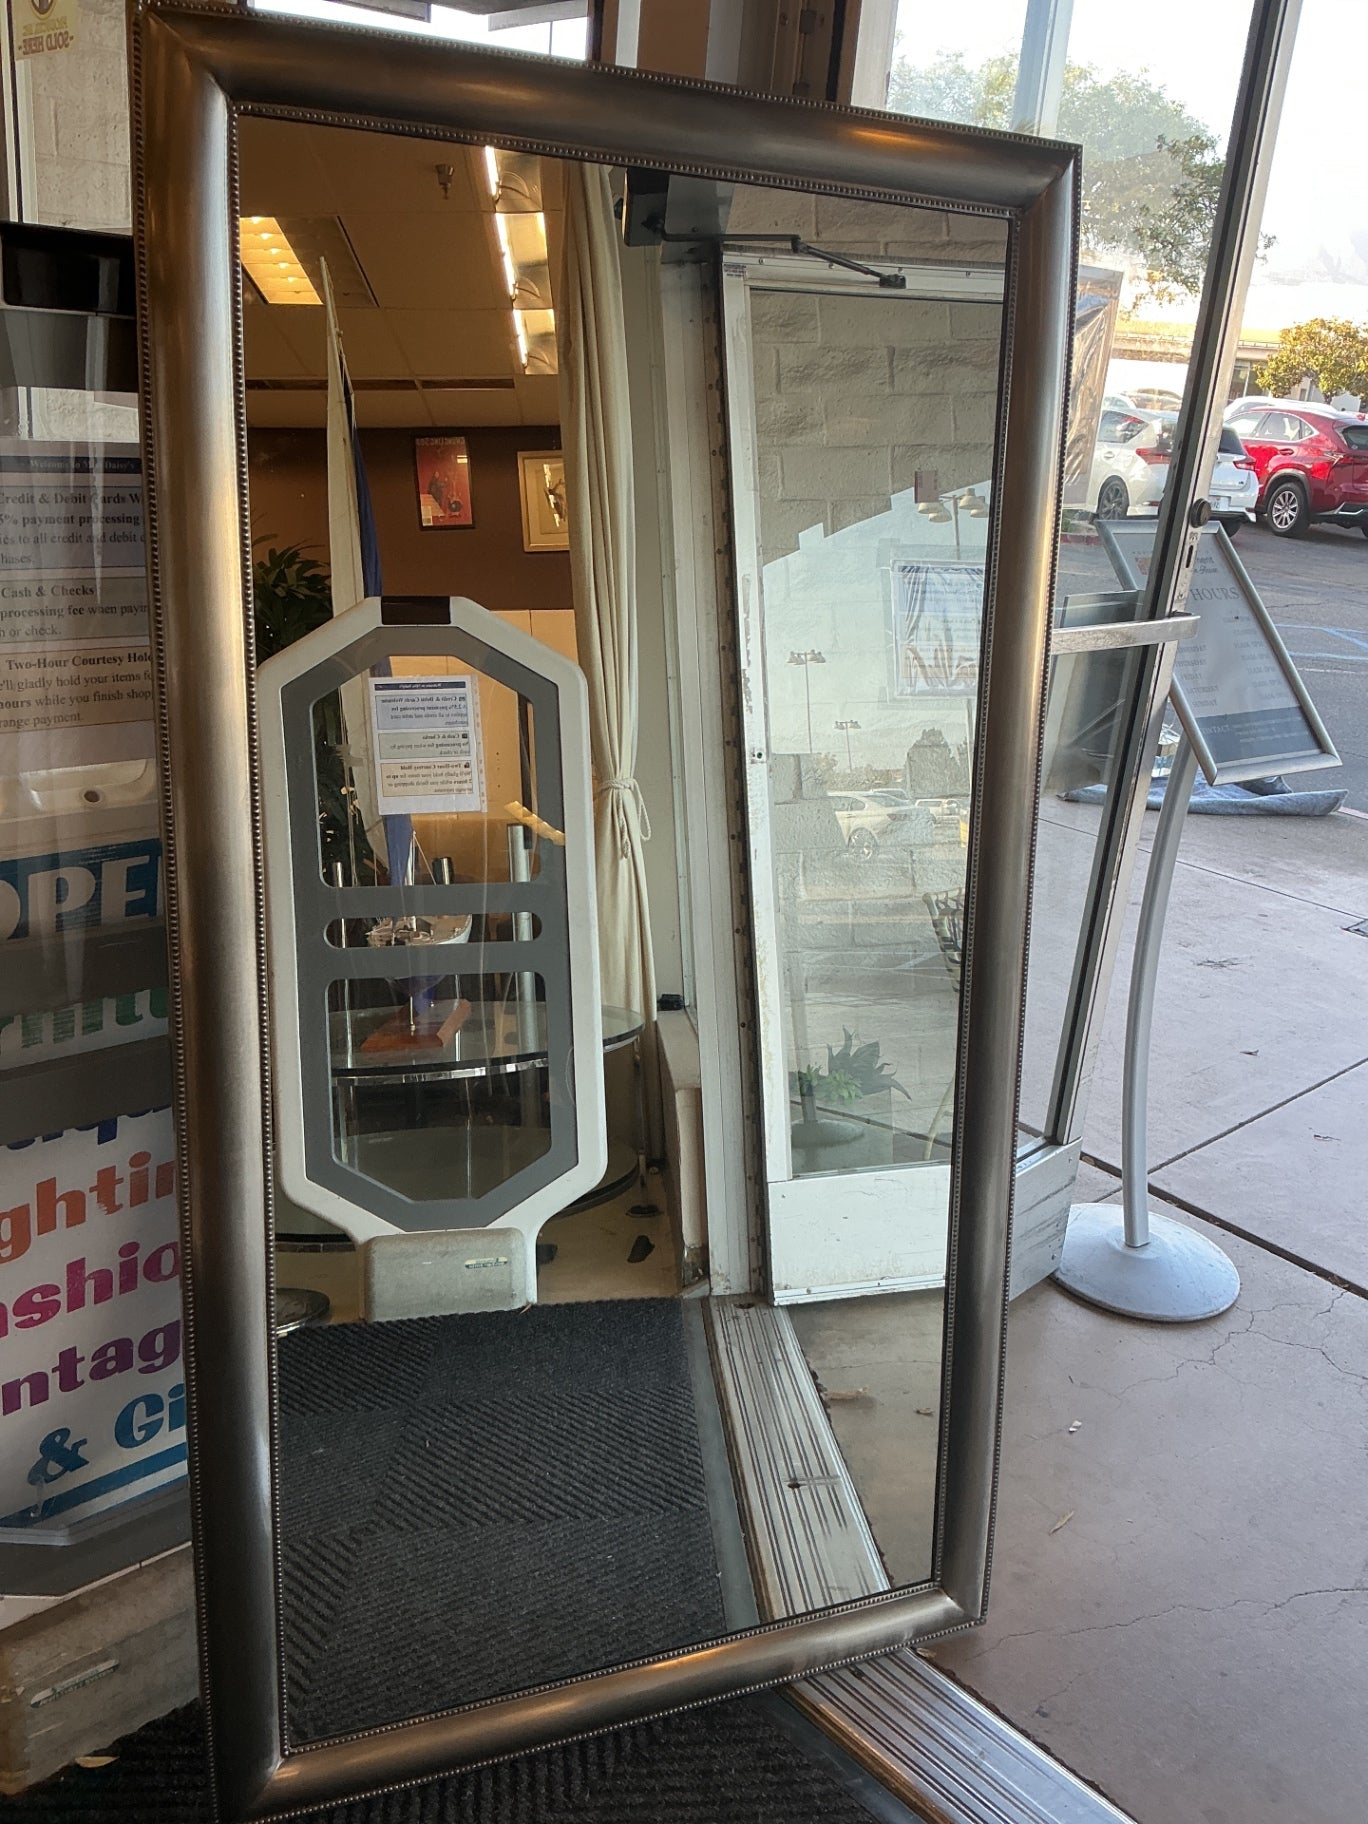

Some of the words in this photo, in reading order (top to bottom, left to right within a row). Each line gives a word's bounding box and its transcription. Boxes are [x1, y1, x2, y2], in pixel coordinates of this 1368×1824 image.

[38, 493, 49, 504] &
[22, 515, 75, 528] payment
[78, 513, 140, 527] prcessing
[50, 532, 82, 544] credit
[86, 532, 106, 543] ad
[110, 531, 137, 543] debit
[1, 586, 31, 599] Cash
[35, 585, 46, 598] &
[51, 584, 95, 597] Checks
[1190, 586, 1239, 600] HOURS
[0, 605, 64, 621] processing
[68, 604, 85, 616] fee
[6, 657, 69, 670] Two-Hour
[71, 654, 124, 667] Courtesy
[17, 676, 52, 692] gladly
[56, 674, 80, 687] hold
[83, 676, 108, 687] your
[111, 671, 141, 683] items
[35, 695, 66, 706] while
[69, 695, 89, 706] you
[93, 689, 123, 702] finish
[0, 854, 166, 941] PE
[0, 1241, 180, 1340] shio
[27, 1427, 90, 1486] &
[114, 1383, 187, 1449] Gi
